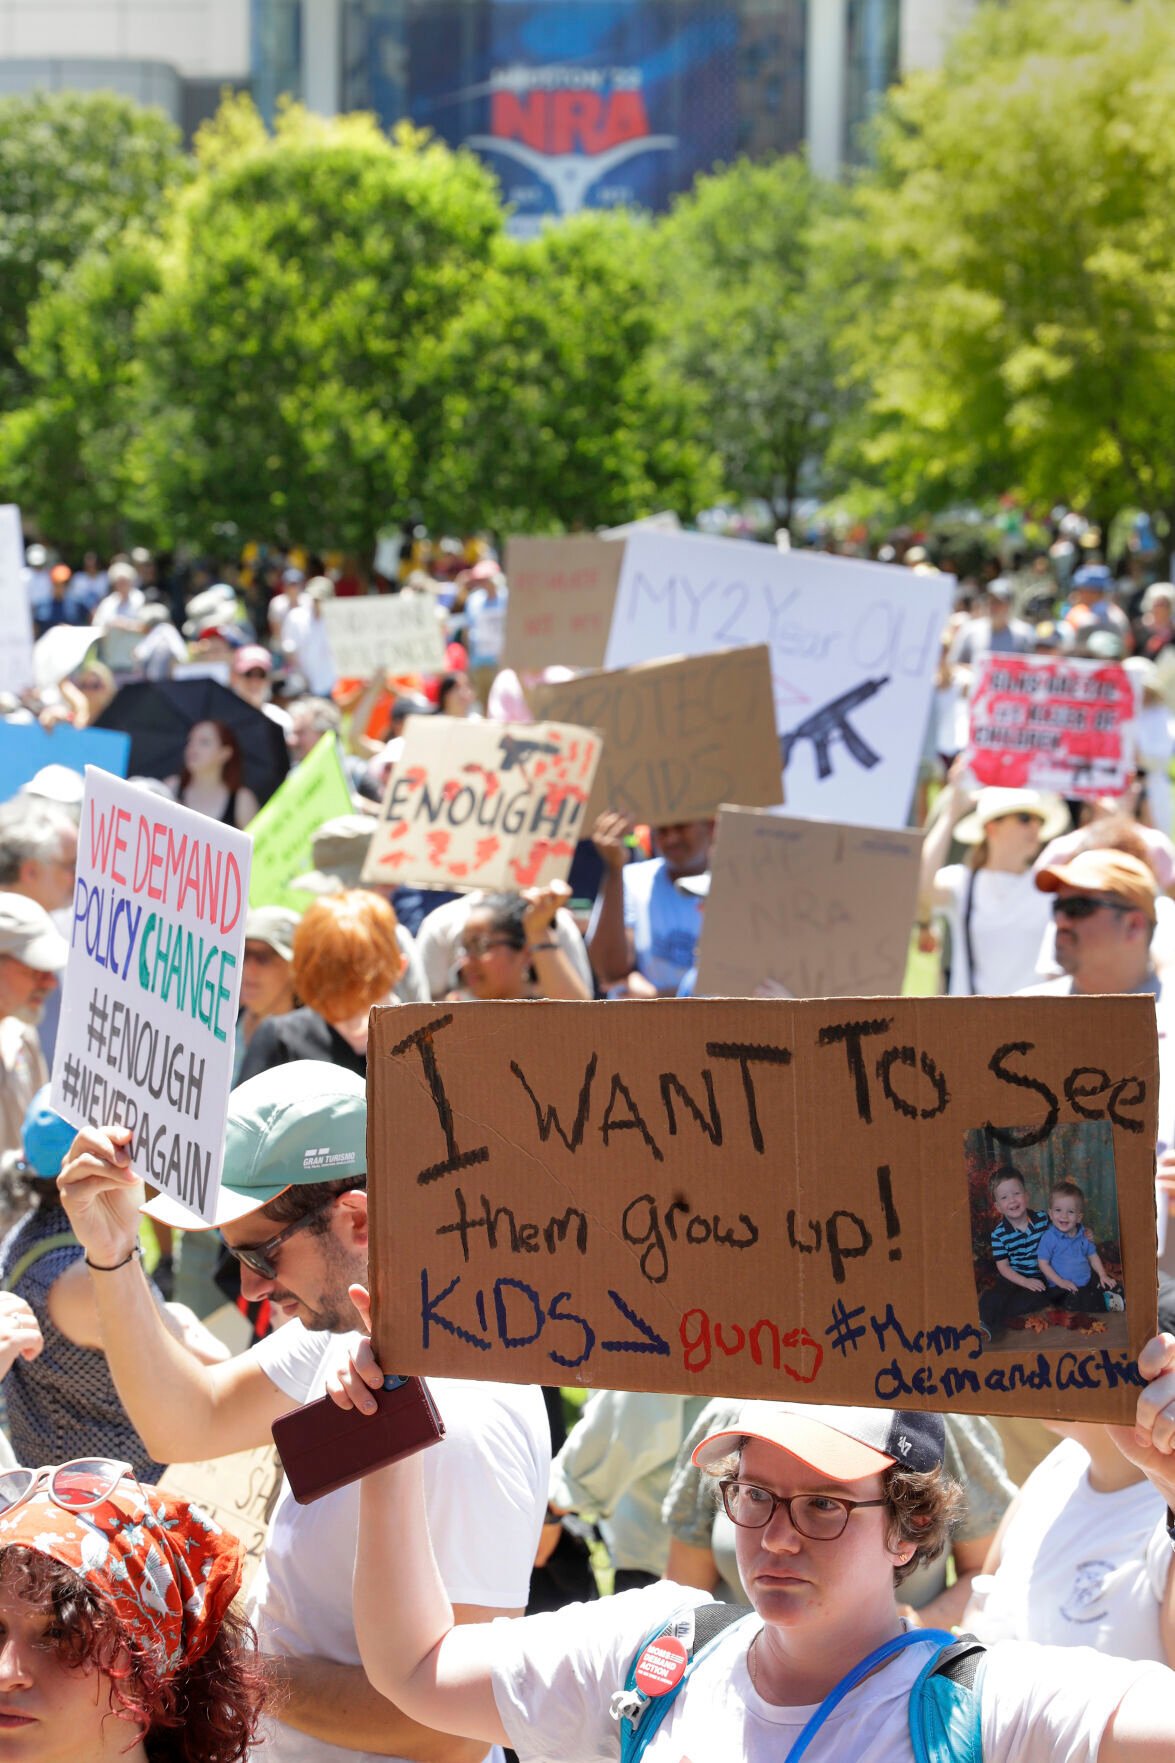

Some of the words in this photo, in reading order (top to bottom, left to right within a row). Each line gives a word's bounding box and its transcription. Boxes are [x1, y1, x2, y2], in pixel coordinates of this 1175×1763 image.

[490, 88, 650, 157] NRA
[627, 571, 717, 634] MY
[713, 579, 750, 644] 2
[763, 583, 845, 660] Year
[850, 599, 941, 678] Old
[385, 778, 583, 839] ENOUGH!
[604, 742, 737, 813] KIDS
[90, 797, 132, 887] WE
[132, 813, 242, 934] DEMAND
[139, 911, 236, 1043] CHANGE
[87, 987, 205, 1120] #ENOUGH
[390, 1013, 490, 1186] I
[511, 1041, 792, 1162] WANT
[816, 1016, 951, 1124] TO
[985, 1041, 1147, 1148] See
[303, 1156, 324, 1167] GRAN
[325, 1151, 356, 1164] TURISMO
[436, 1187, 588, 1263] them
[622, 1194, 760, 1284] grow
[787, 1165, 903, 1284] up!
[420, 1268, 596, 1368] KIDS
[679, 1307, 824, 1384] guns
[640, 1662, 669, 1678] ACTION
[643, 1653, 677, 1671] DEMAND
